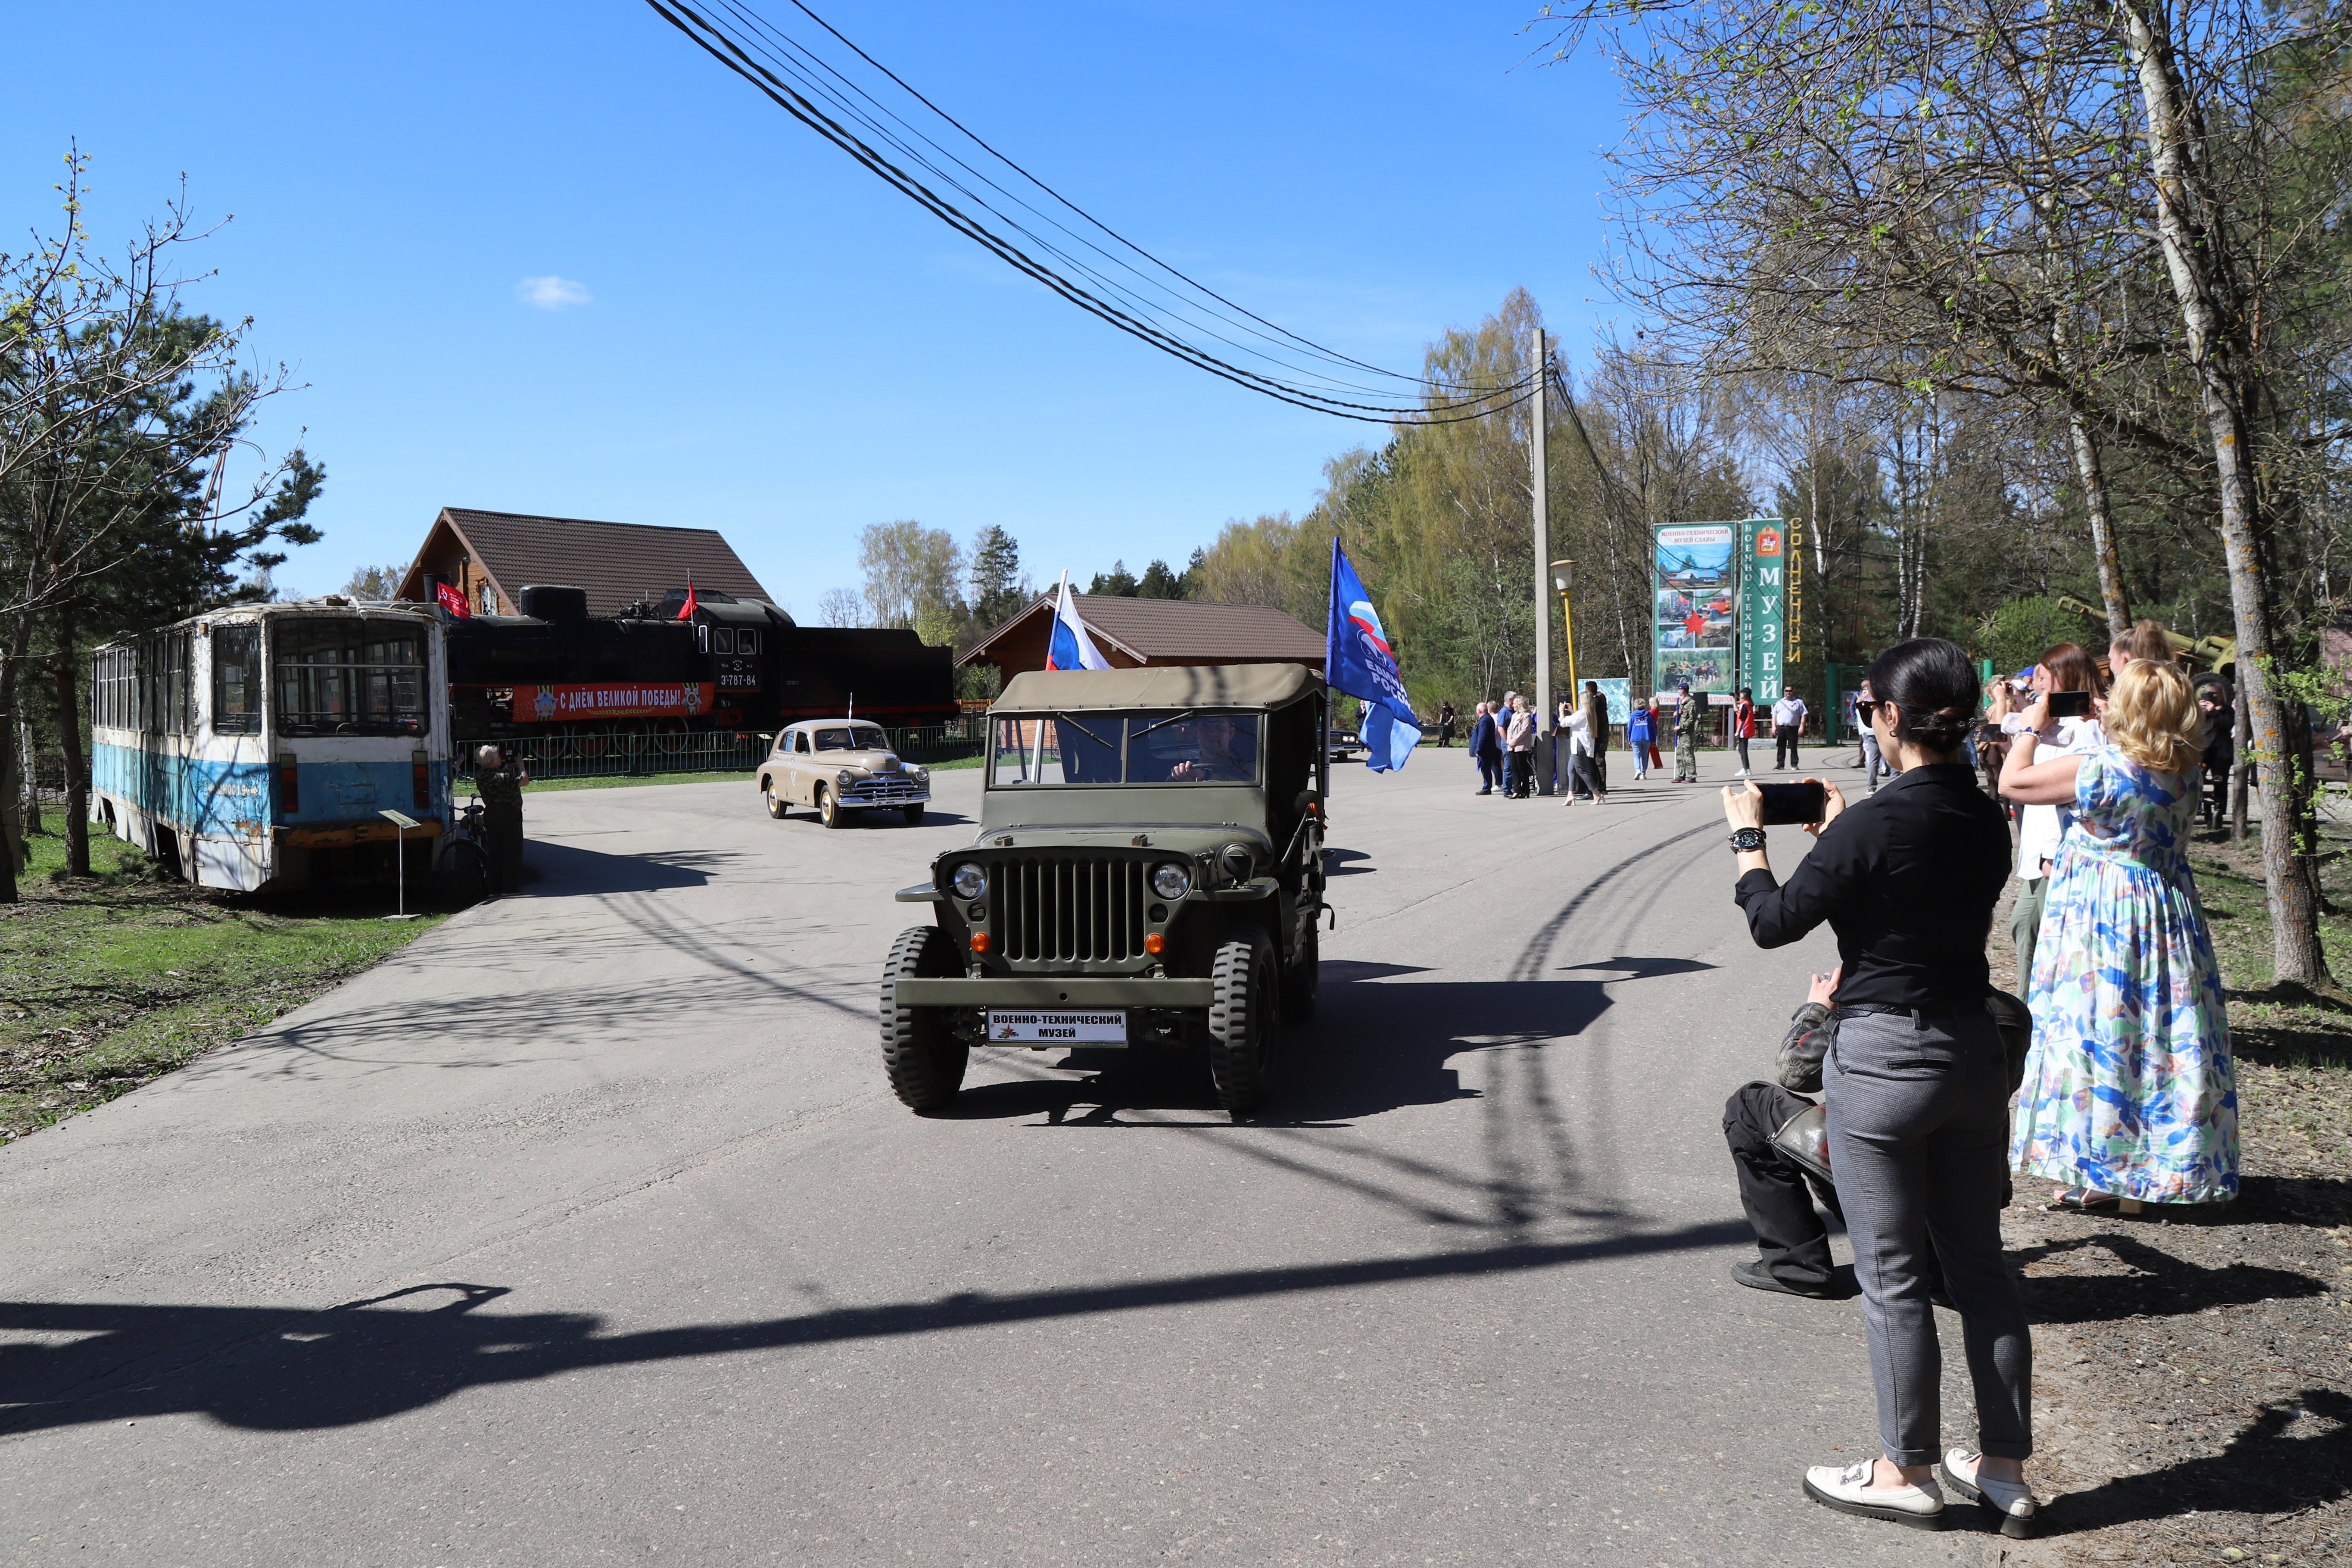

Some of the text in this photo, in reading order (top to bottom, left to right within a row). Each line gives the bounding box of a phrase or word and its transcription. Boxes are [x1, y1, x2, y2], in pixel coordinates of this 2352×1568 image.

[1744, 524, 1752, 689] ВОЕННО-ТЕХНИЧЕСКИ
[1759, 567, 1780, 699] МУЗЕЙ
[1364, 658, 1408, 698] ЕДИНА
[560, 685, 680, 711] С ДНЁМ ВЕЛИКОЙ ПОБЕДЫ!
[993, 1014, 1121, 1025] ВОЕННО-ТЕХНИЧЕСКИЙ
[1038, 1027, 1076, 1038] МУЗЕЙ
